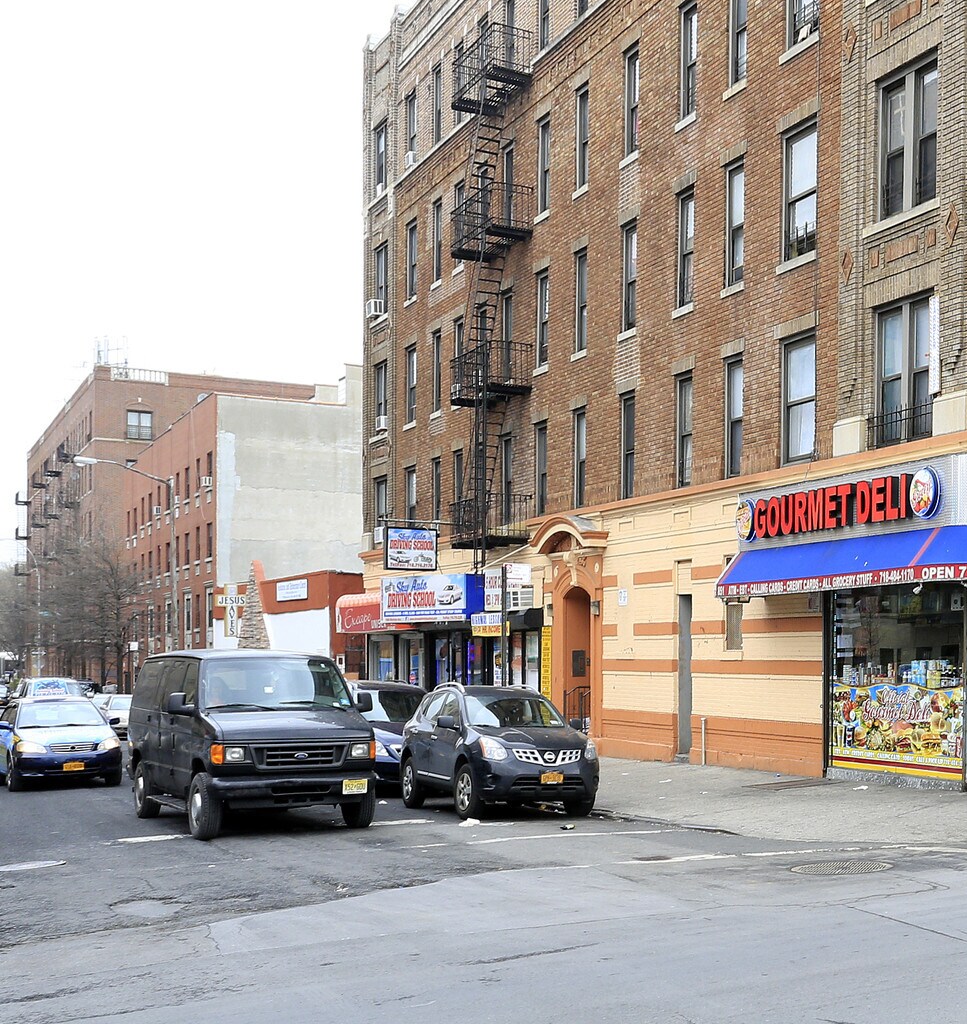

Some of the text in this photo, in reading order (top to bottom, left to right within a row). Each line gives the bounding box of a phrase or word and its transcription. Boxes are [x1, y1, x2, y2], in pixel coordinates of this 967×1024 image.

[754, 474, 907, 538] GOURMET DELI
[390, 540, 434, 550] DRIVING SCHOOL
[922, 566, 954, 579] OPEN
[959, 566, 967, 578] 7
[750, 583, 768, 594] CALLING
[769, 582, 783, 593] CARDS
[787, 581, 803, 591] CREDIT
[804, 579, 819, 590] CARDS
[822, 578, 831, 588] ALL
[832, 575, 856, 587] GROCERY
[856, 573, 873, 585] STUFF
[219, 596, 245, 604] JESUS
[388, 591, 436, 608] DRIVING SCHOOL
[863, 700, 931, 721] Gourmet Deli
